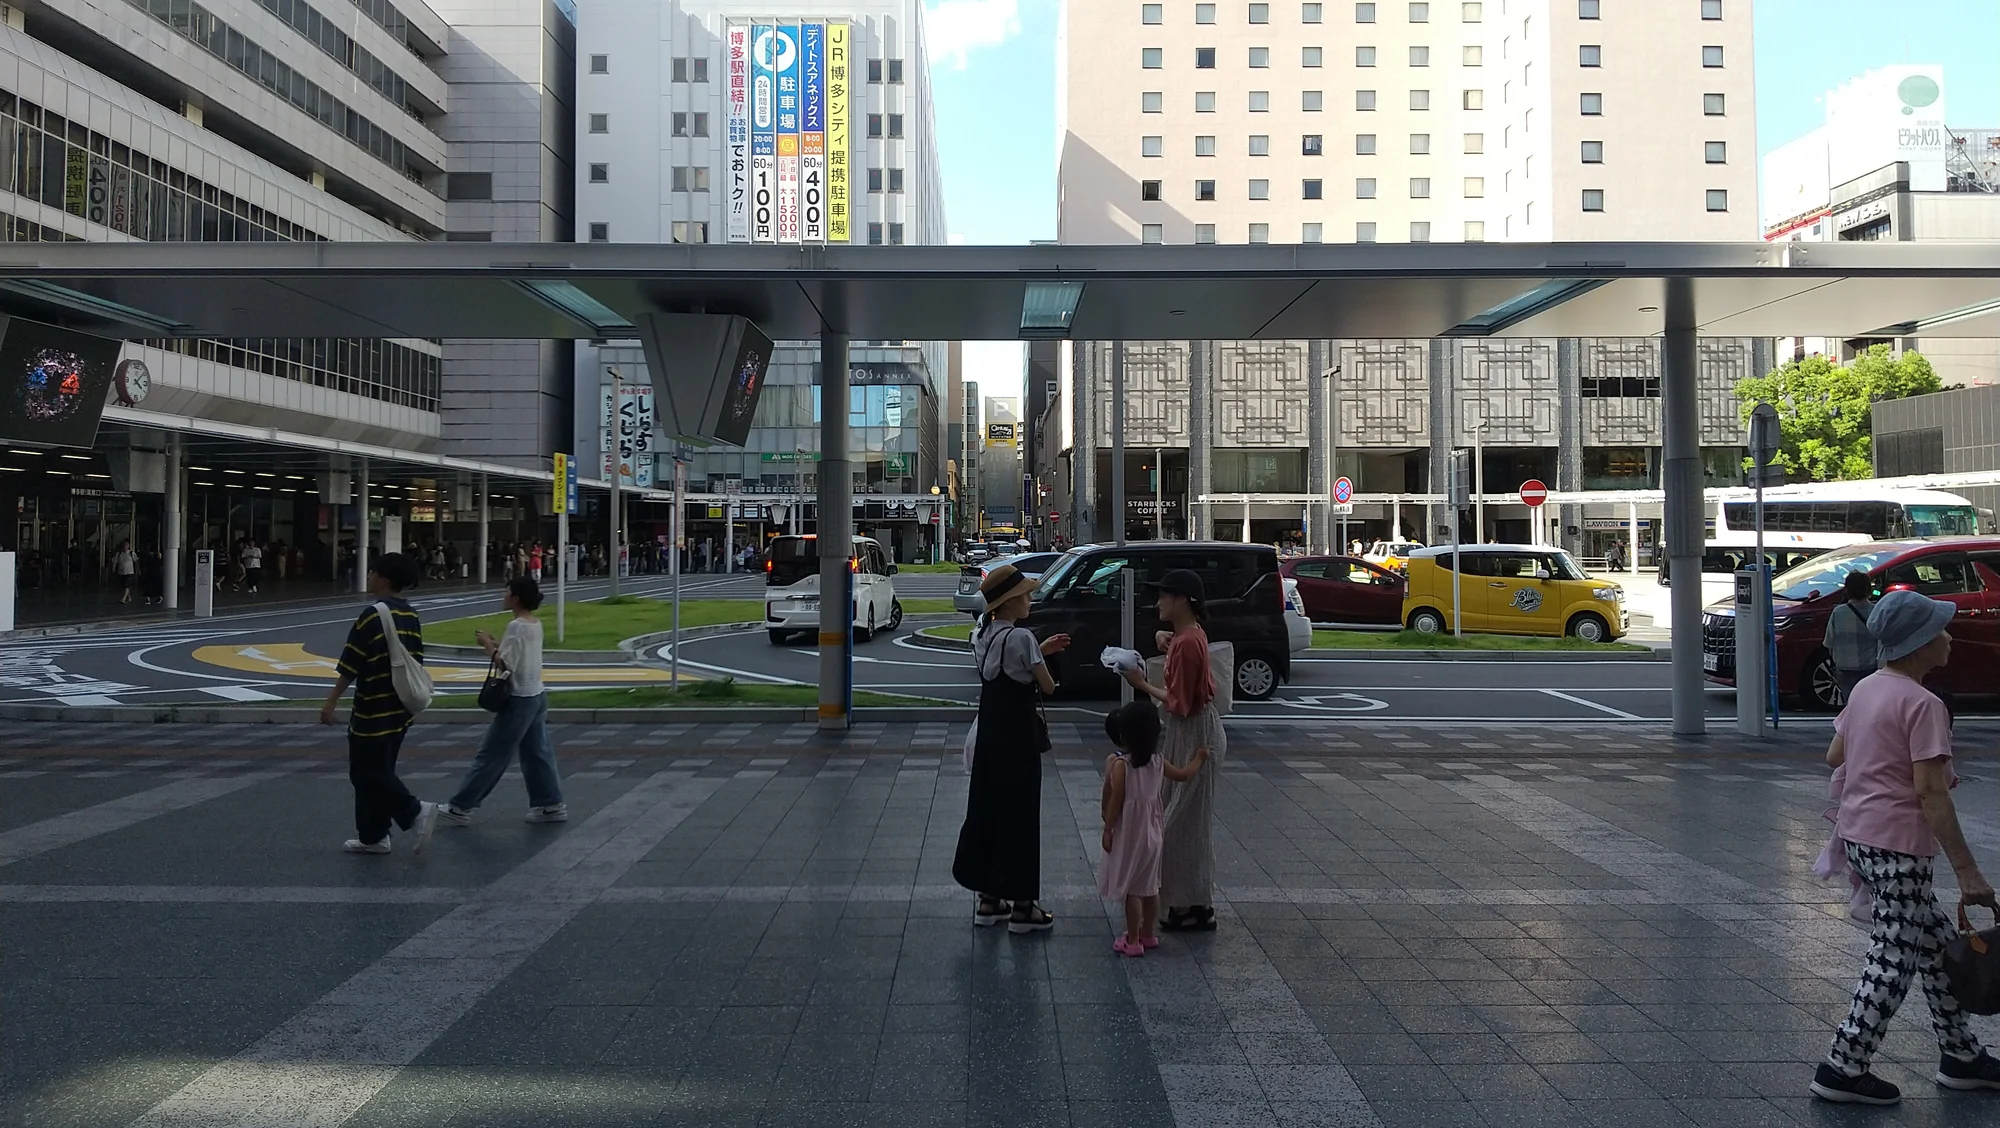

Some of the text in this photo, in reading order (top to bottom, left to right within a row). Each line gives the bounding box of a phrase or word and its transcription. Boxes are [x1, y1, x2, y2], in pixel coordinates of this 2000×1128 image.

[757, 80, 768, 124] 24時間営業
[780, 77, 796, 129] 駐車場
[806, 29, 819, 127] デイトスアネックス
[830, 29, 846, 235] JR博多シティ提携駐車場
[1898, 128, 1941, 146] ピタットハウス
[756, 171, 770, 238] 100円
[806, 171, 820, 237] 400円
[619, 401, 636, 460] くじら
[636, 395, 653, 452] しらす
